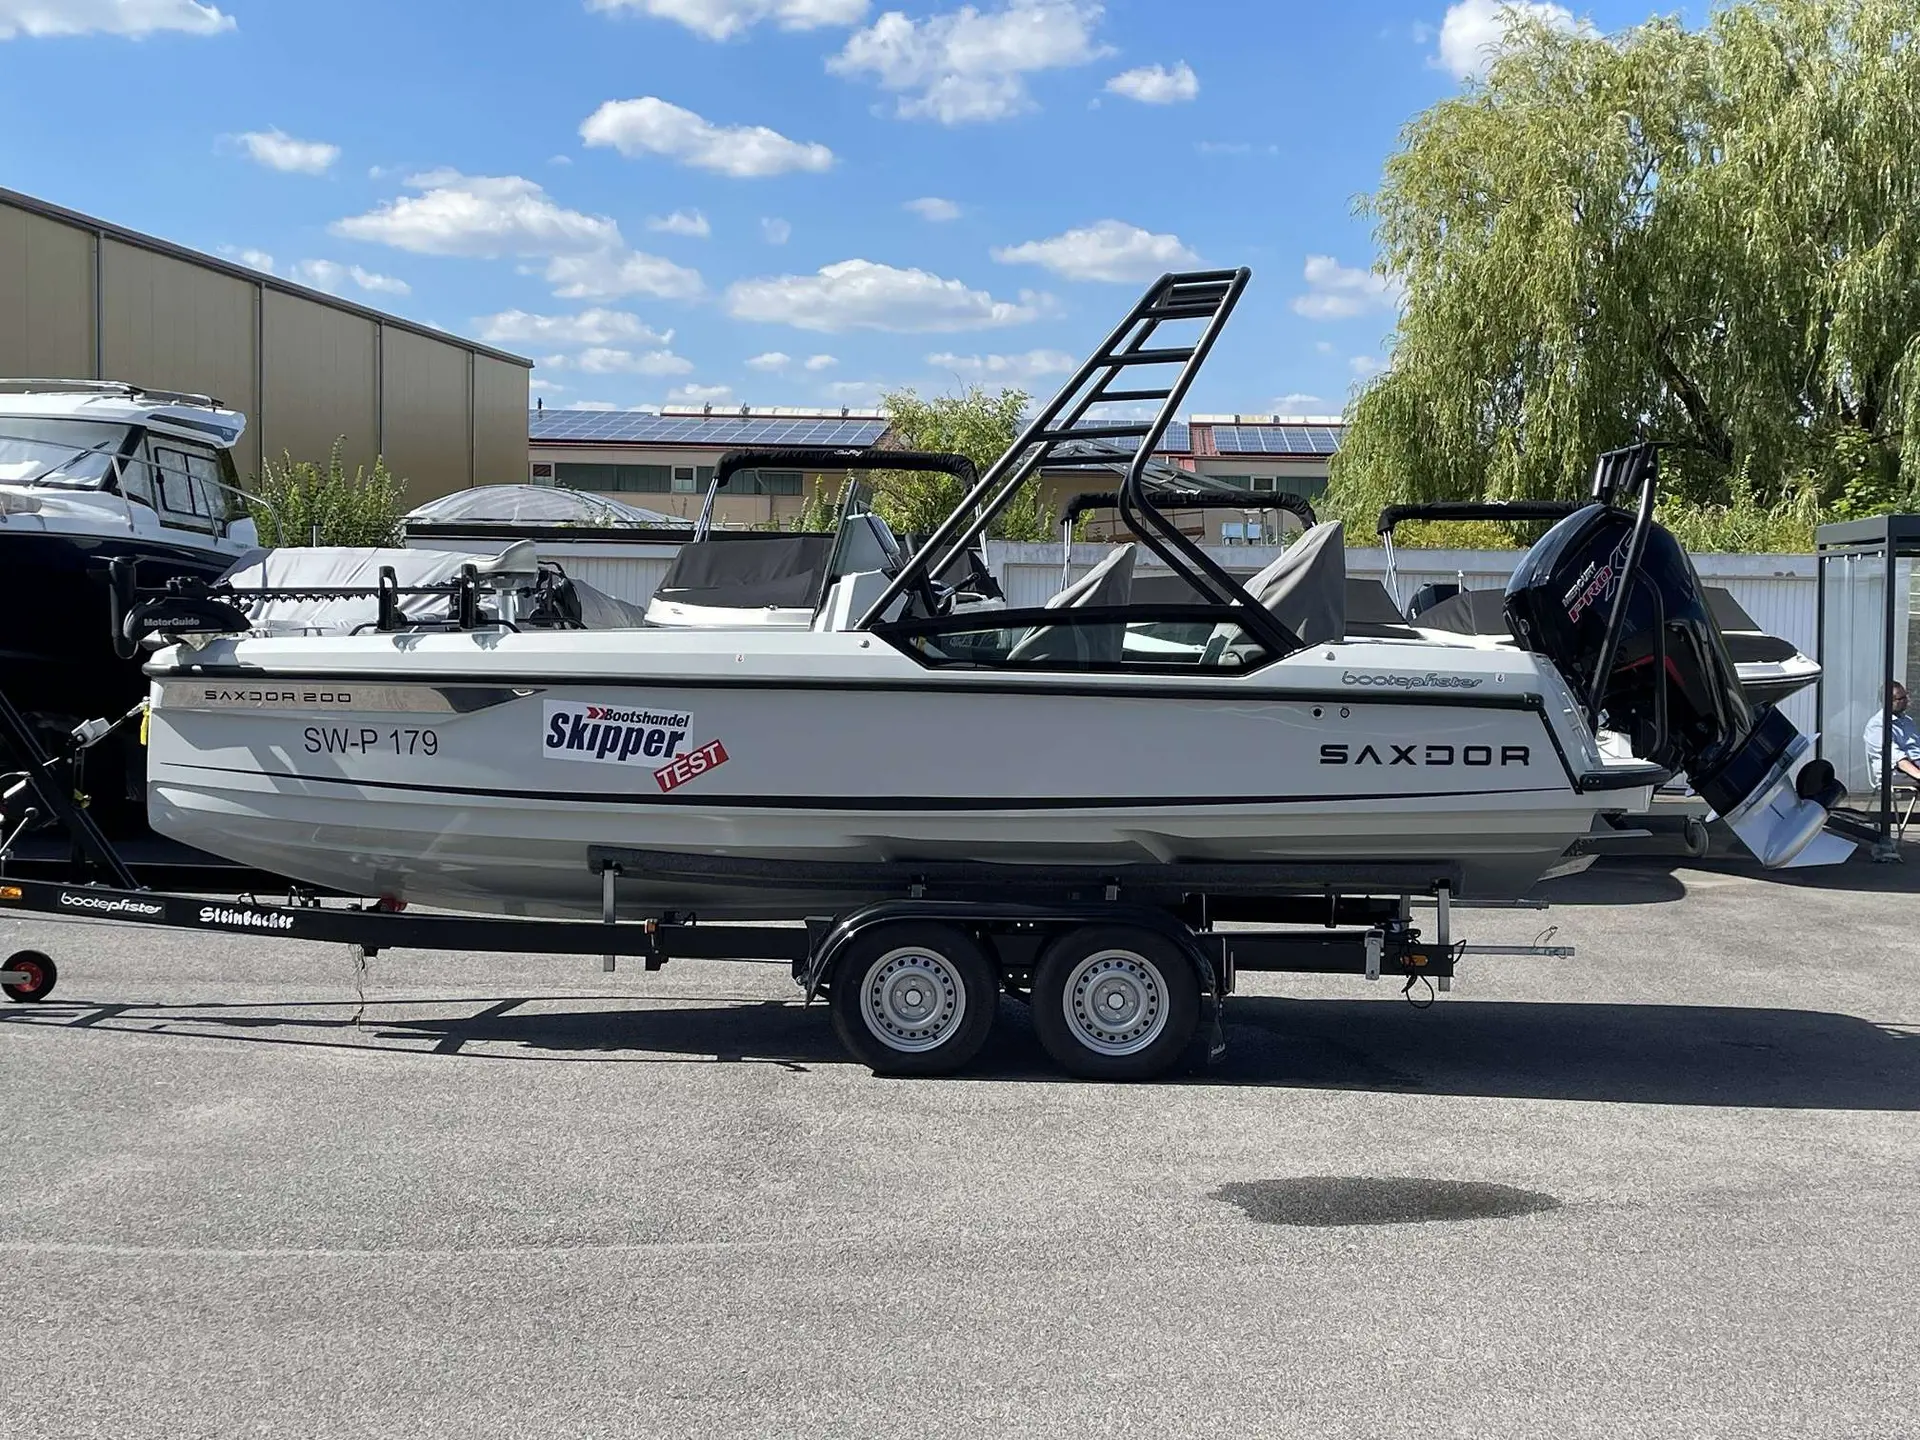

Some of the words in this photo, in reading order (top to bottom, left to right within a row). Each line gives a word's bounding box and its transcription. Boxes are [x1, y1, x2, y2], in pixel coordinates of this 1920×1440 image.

[1562, 560, 1598, 607] MERCURY
[1568, 565, 1613, 623] PRO
[143, 617, 200, 627] MotorGuide
[1341, 670, 1483, 689] bootepfister
[204, 690, 295, 701] SAXDOR
[303, 692, 351, 703] 200
[605, 708, 691, 728] Bootshandel
[303, 726, 378, 755] SW-P
[389, 729, 438, 757] 179
[546, 712, 686, 762] Skipper
[656, 741, 720, 790] TEST
[1319, 744, 1530, 766] SAXDOR
[59, 891, 163, 915] bootepfister
[199, 906, 295, 930] Steinbacher
